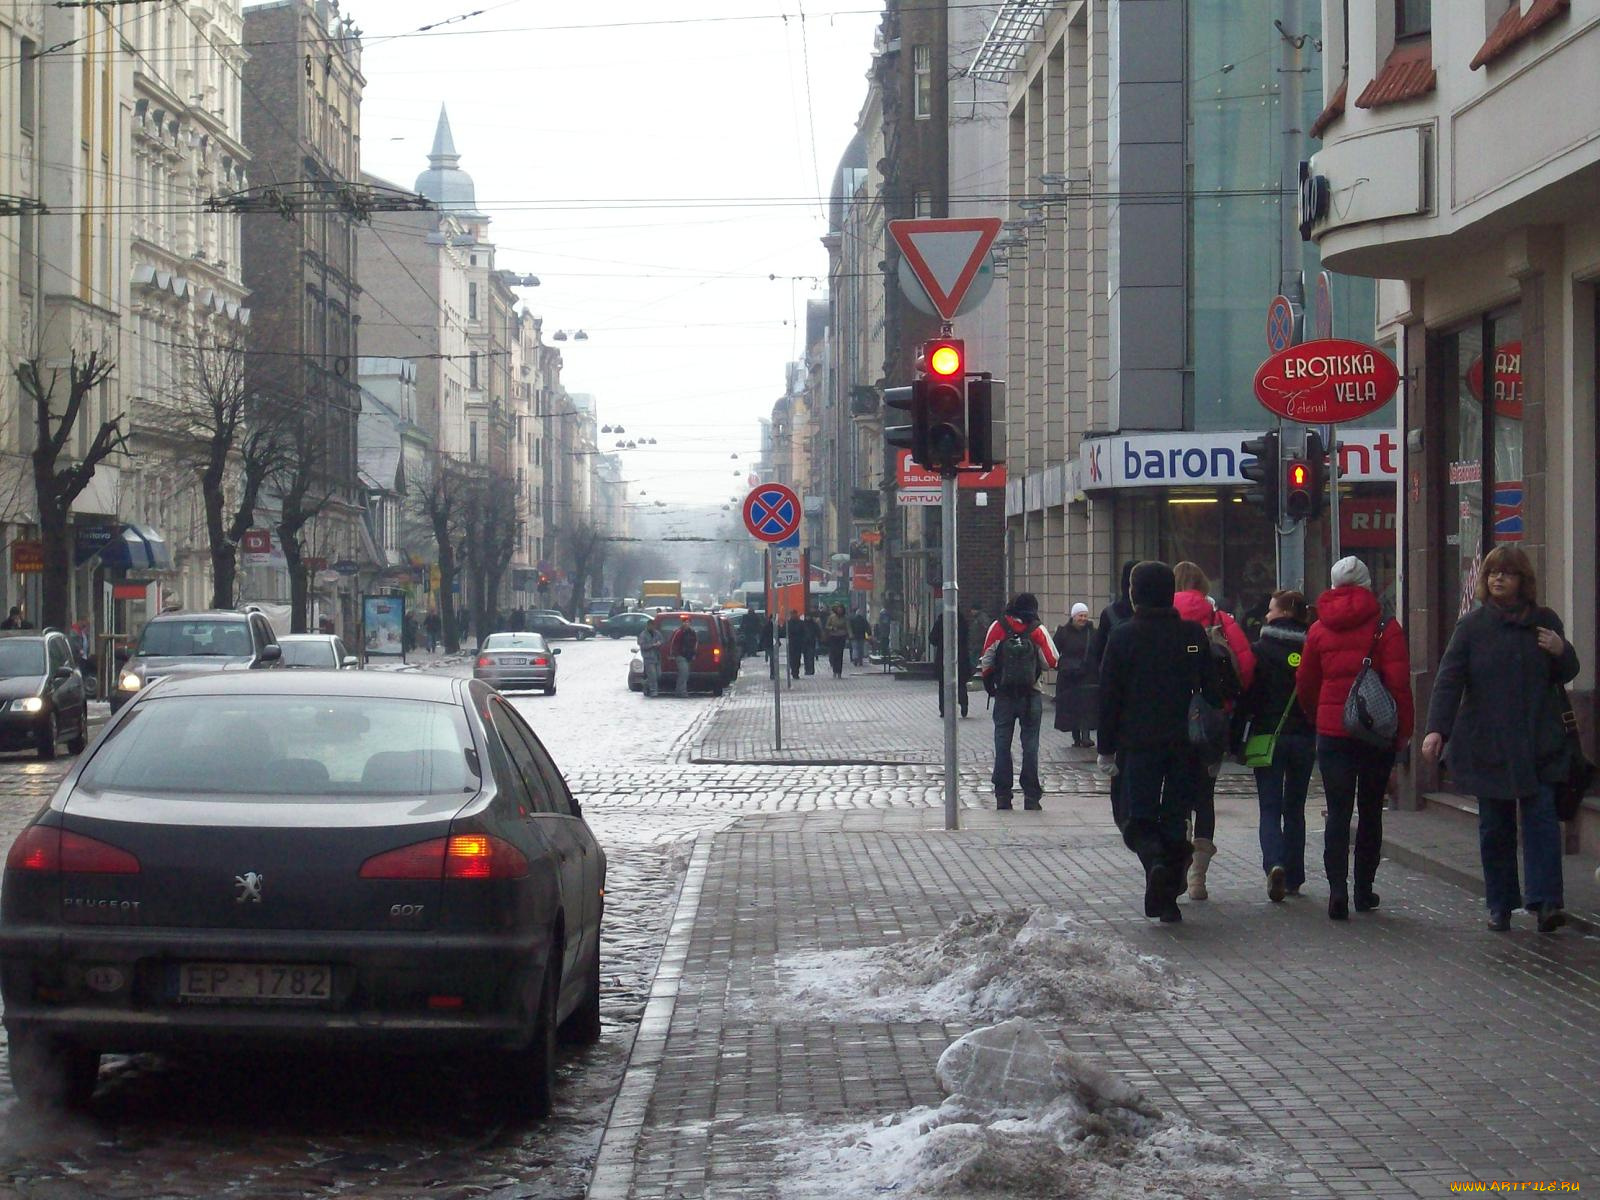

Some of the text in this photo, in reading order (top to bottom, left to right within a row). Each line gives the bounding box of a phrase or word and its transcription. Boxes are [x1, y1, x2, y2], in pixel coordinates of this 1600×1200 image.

[1284, 350, 1376, 380] EROTISKĀ
[1335, 381, 1377, 403] VEĻA
[1338, 433, 1398, 475] nt
[63, 898, 141, 909] PEUGEOT
[390, 904, 425, 916] 607
